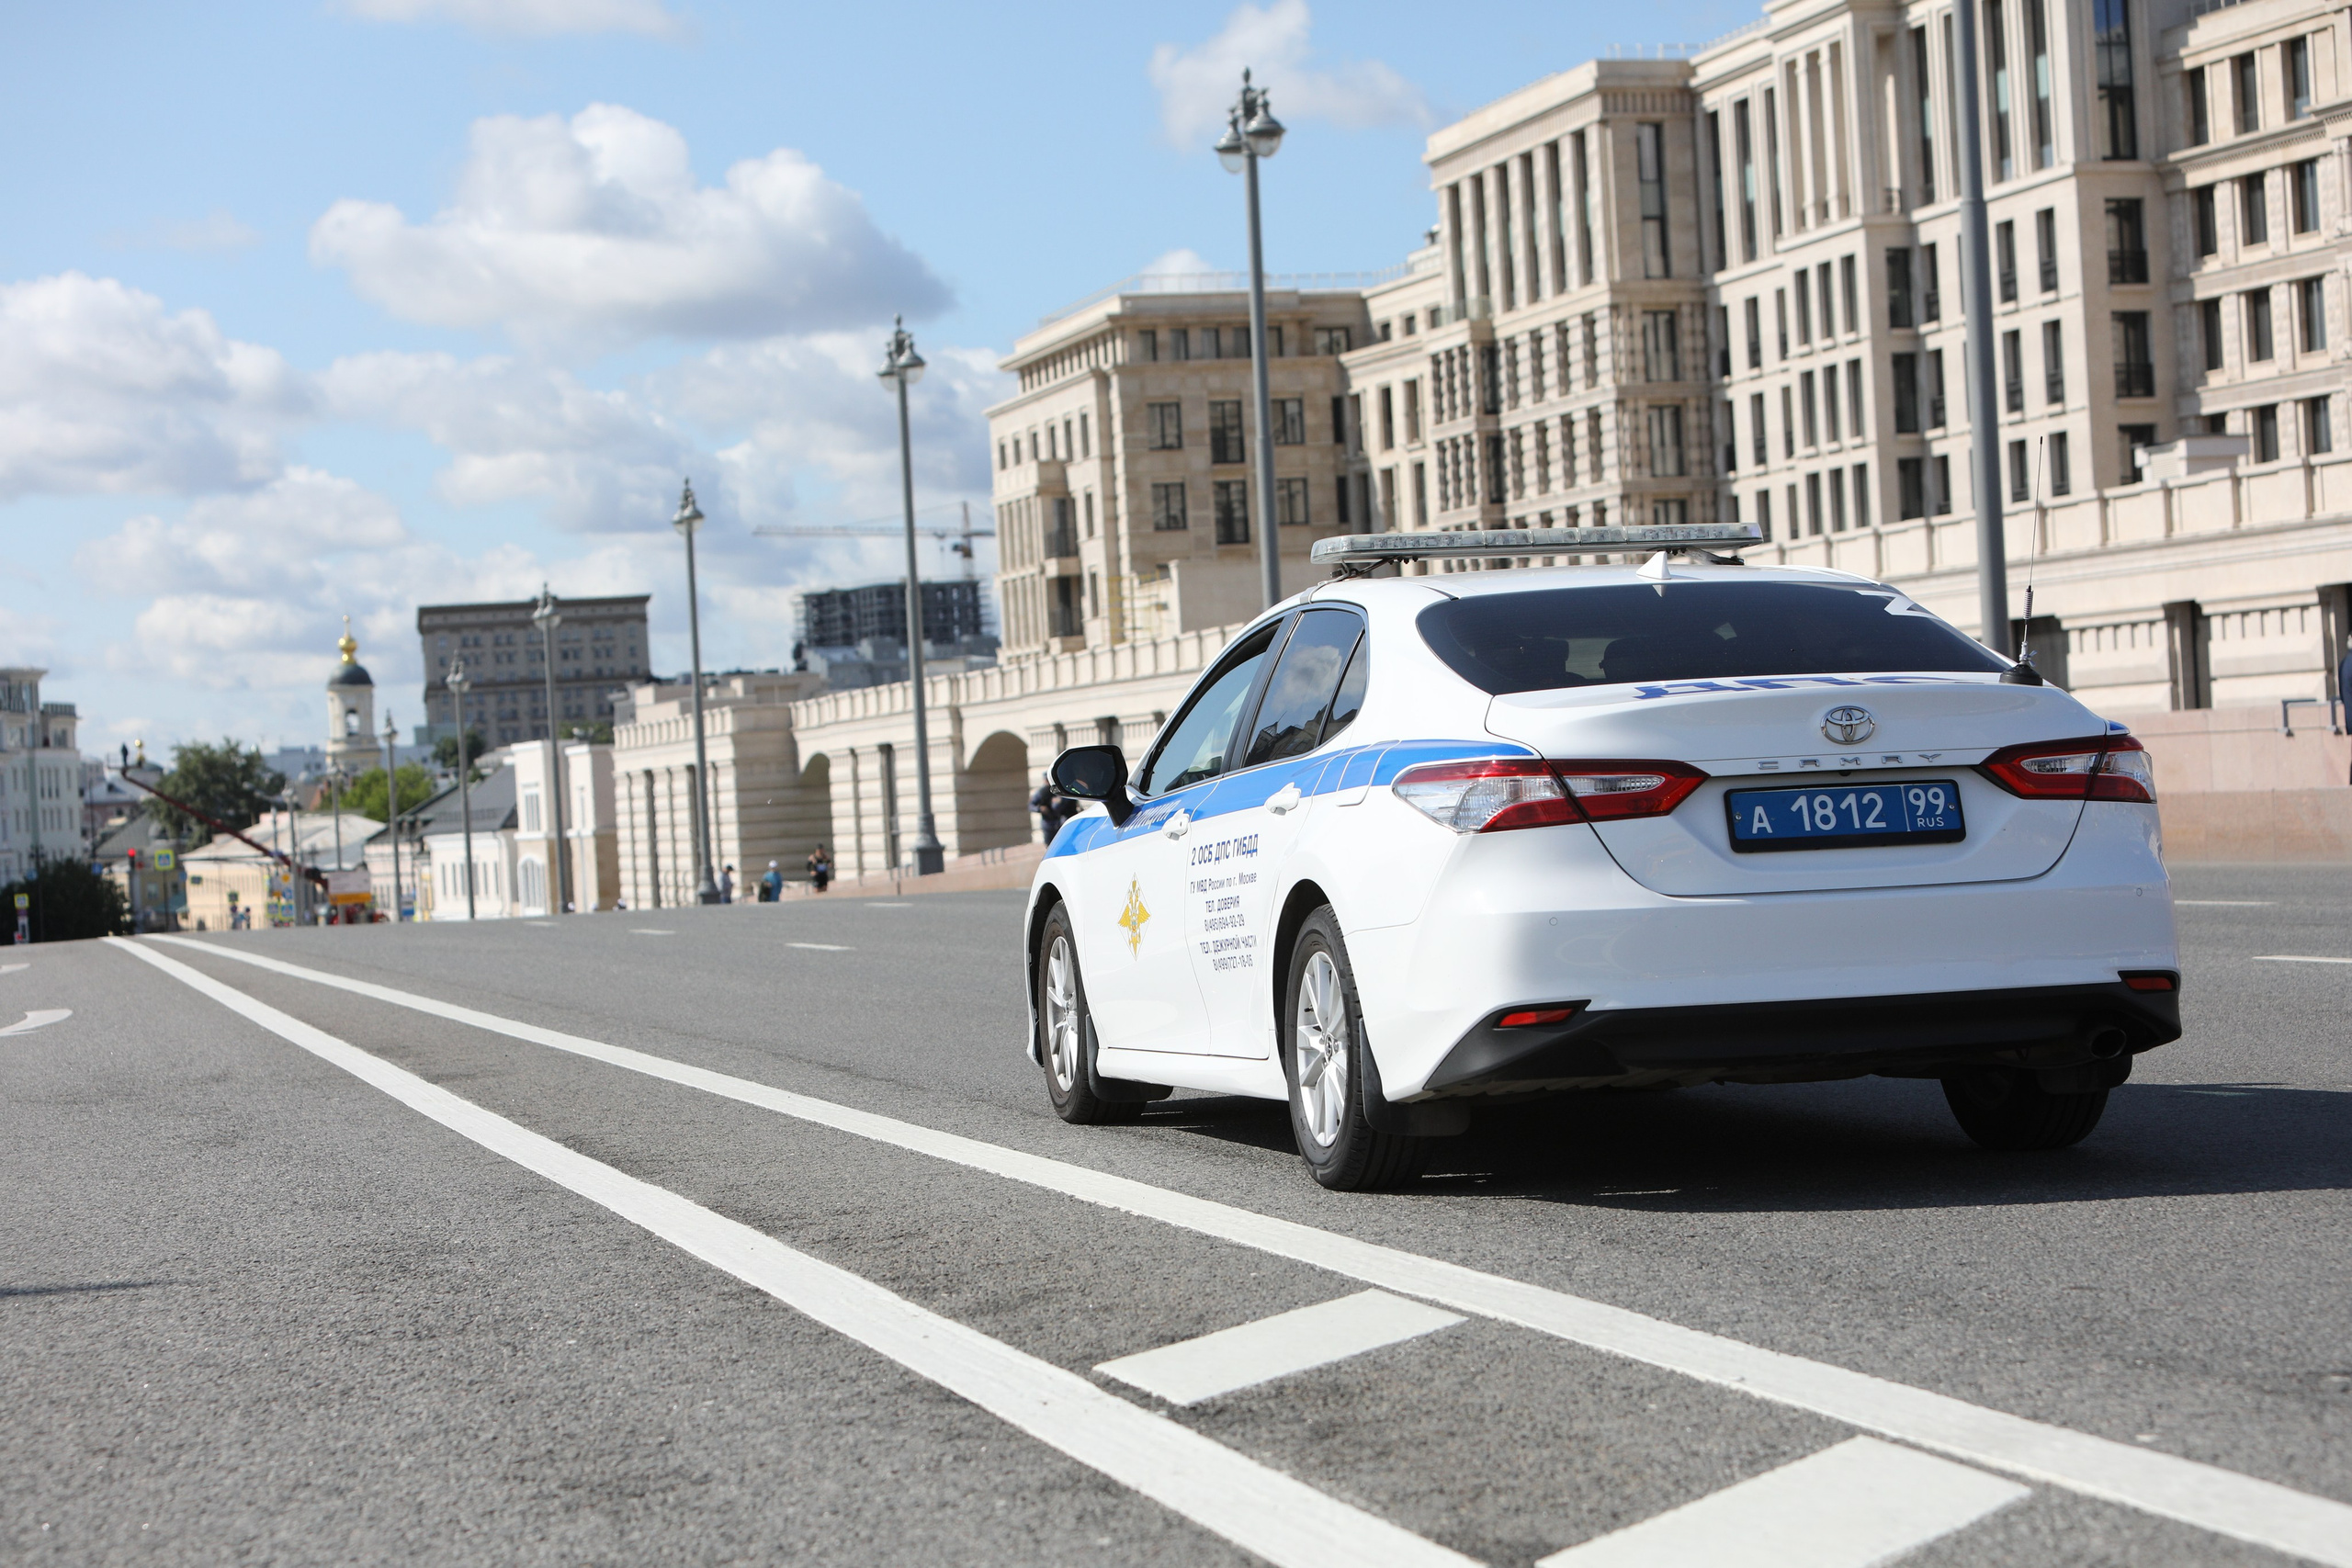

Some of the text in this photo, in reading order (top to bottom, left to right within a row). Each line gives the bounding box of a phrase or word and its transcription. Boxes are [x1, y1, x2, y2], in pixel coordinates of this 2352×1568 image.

[1758, 753, 1943, 770] CAMRY
[1790, 792, 1887, 831] 1812
[1908, 787, 1946, 816] 99
[1917, 816, 1945, 828] RUS
[1191, 833, 1259, 866] 2 ОСБ ДПС ГИБДД
[1190, 881, 1196, 895] ГУ
[1196, 878, 1208, 895] МВД
[1208, 877, 1226, 891] России
[1226, 877, 1232, 888] по
[1238, 872, 1258, 886] Москве
[1216, 895, 1240, 914] ДОВЕРИЯ
[1212, 934, 1241, 955] ДЕЖУРНОЙ
[1240, 934, 1258, 949] ЧАСТИ
